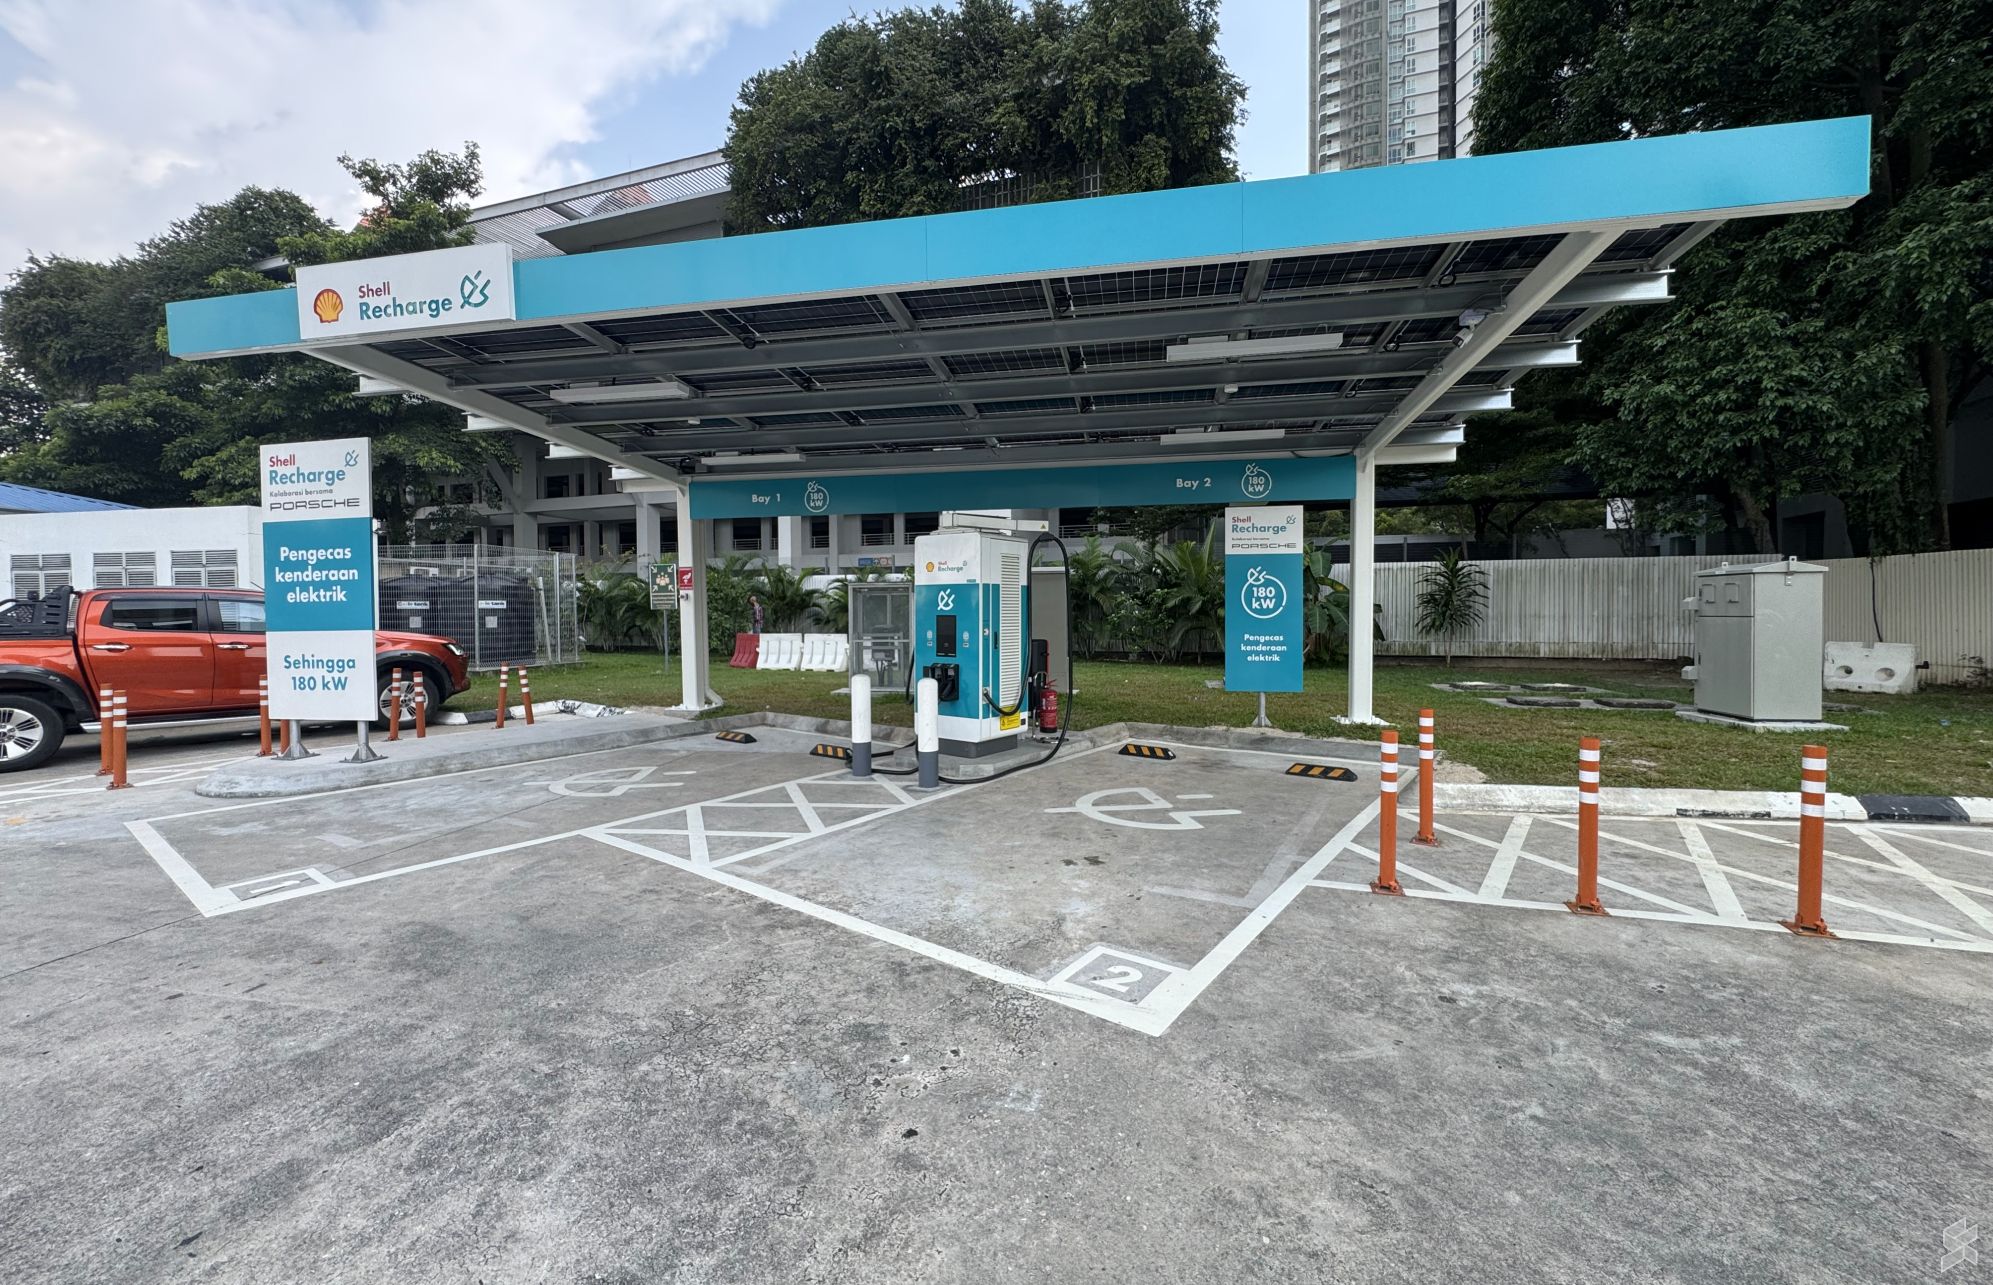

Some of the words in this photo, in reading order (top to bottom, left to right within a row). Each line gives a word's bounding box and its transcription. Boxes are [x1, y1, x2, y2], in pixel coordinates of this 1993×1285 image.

[358, 281, 391, 299] Shell
[359, 297, 453, 320] Recharge
[269, 454, 296, 467] Shell
[269, 467, 346, 486] Recharge
[1248, 476, 1265, 484] 180
[1176, 479, 1199, 490] Bay
[1204, 478, 1211, 487] 2
[270, 498, 360, 511] PORSCHE
[752, 494, 771, 505] Bay
[776, 493, 781, 502] 1
[1232, 516, 1252, 524] Shell
[1232, 523, 1287, 535] Recharge
[280, 546, 352, 565] Pengecas
[275, 565, 359, 583] kenderaan
[287, 585, 348, 603] elektrik
[1252, 587, 1276, 598] 180
[1252, 598, 1276, 609] kW
[1244, 634, 1284, 643] Pengecas
[1241, 643, 1287, 652] kenderaan
[284, 653, 356, 674] Sehingga
[1247, 653, 1281, 662] elektrik
[291, 676, 317, 691] 180
[321, 675, 348, 691] kW
[1090, 965, 1143, 993] 2
